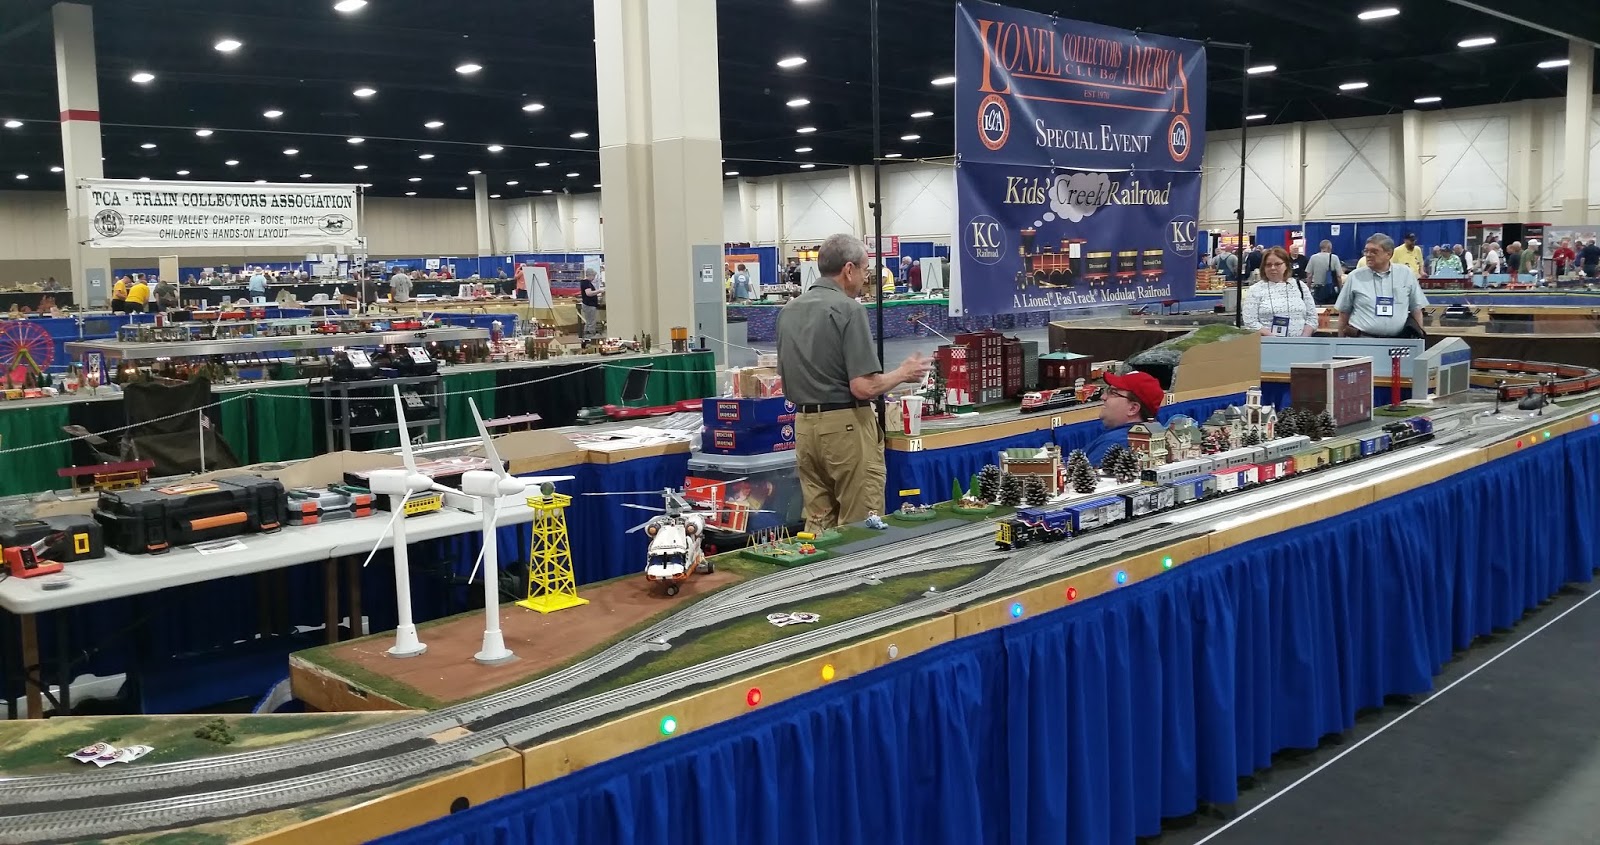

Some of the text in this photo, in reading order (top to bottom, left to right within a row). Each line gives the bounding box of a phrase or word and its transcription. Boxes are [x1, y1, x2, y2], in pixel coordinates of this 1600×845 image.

[1062, 32, 1122, 68] COLLECTORS
[1122, 44, 1191, 114] AMERICA
[1065, 65, 1108, 79] CLUB
[1083, 89, 1097, 98] EST
[1035, 118, 1098, 150] SPECIAL
[1100, 124, 1152, 153] EVENT
[92, 191, 352, 209] TCA TRAIN COLLECTORS ASSOCIATION
[1055, 178, 1108, 209] Creek
[1105, 181, 1172, 206] Railroad
[128, 214, 173, 225] TREASURE
[177, 214, 209, 225] VALLEY
[213, 215, 250, 225] CHAPTER
[290, 215, 314, 225] IDAHO
[159, 228, 289, 239] CHILDREN'S HANDS-ON LAYOUT
[972, 222, 1001, 248] KC
[1171, 220, 1196, 243] KC
[976, 249, 999, 258] Railroad
[1175, 243, 1195, 252] Railroad
[1013, 295, 1022, 308] A
[1101, 287, 1135, 303] Modular
[1137, 284, 1171, 300] Railroad
[911, 440, 920, 451] 7A
